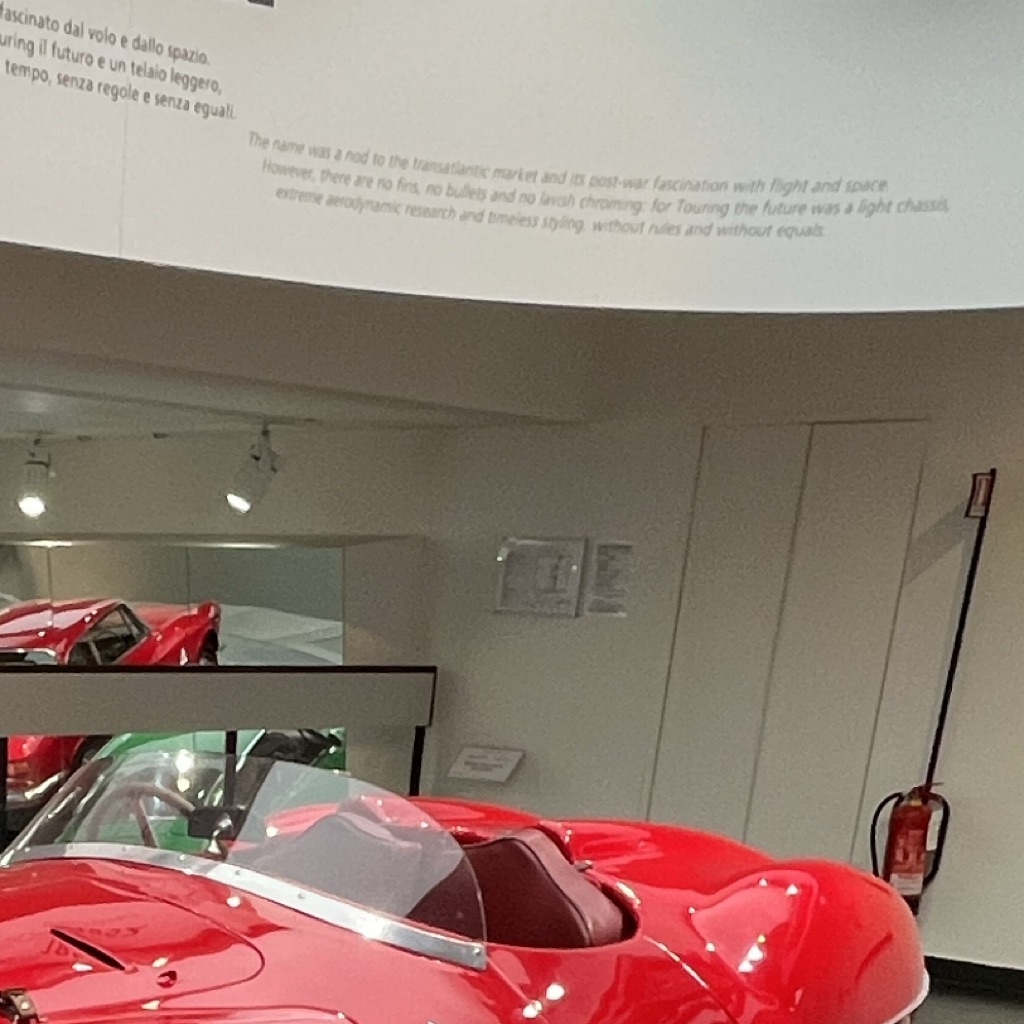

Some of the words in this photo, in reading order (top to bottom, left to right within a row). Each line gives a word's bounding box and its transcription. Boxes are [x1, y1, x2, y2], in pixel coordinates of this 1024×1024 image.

[39, 39, 48, 55] il
[51, 40, 94, 67] futuro
[109, 57, 127, 73] un
[131, 61, 167, 82] telaio
[170, 67, 222, 96] leggero,
[63, 19, 85, 38] dal
[88, 26, 117, 46] volo
[120, 35, 128, 48] e
[131, 35, 164, 56] dallo
[167, 46, 210, 66] spazio.
[5, 59, 52, 88] tempo,
[57, 72, 93, 92] senza
[97, 80, 140, 102] regole
[143, 90, 151, 104] e
[155, 93, 190, 112] senza
[249, 130, 271, 150] The
[272, 138, 306, 156] name
[308, 144, 331, 160] was
[334, 147, 343, 162] a
[344, 147, 371, 165] nod
[372, 152, 386, 168] to
[388, 153, 410, 171] the
[413, 156, 490, 180] transatlantic
[492, 166, 539, 184] market
[541, 169, 569, 186] and
[571, 170, 586, 187] its
[588, 174, 650, 191] post-war
[652, 175, 729, 194] fascination
[733, 178, 765, 194] with
[769, 176, 809, 198] flight
[811, 177, 843, 194] and
[262, 158, 316, 183] However,
[320, 167, 352, 187] there
[354, 174, 374, 190] are
[377, 176, 393, 191] no
[425, 182, 442, 197] no
[445, 182, 488, 202] bullets
[490, 188, 517, 203] and
[519, 191, 536, 205] no
[538, 190, 576, 208] lavish
[651, 198, 673, 214] for
[676, 198, 730, 219] Touring
[734, 201, 759, 216] the
[762, 199, 808, 217] future
[811, 202, 841, 215] was
[844, 202, 854, 216] a
[857, 197, 893, 219] light
[276, 187, 324, 206] extreme
[325, 194, 403, 215] aerodynamic
[405, 203, 456, 220] research
[459, 208, 485, 223] and
[487, 210, 539, 229] timeless
[593, 218, 645, 236] without
[647, 220, 682, 237] rules
[685, 221, 714, 238] and
[716, 222, 775, 238] without
